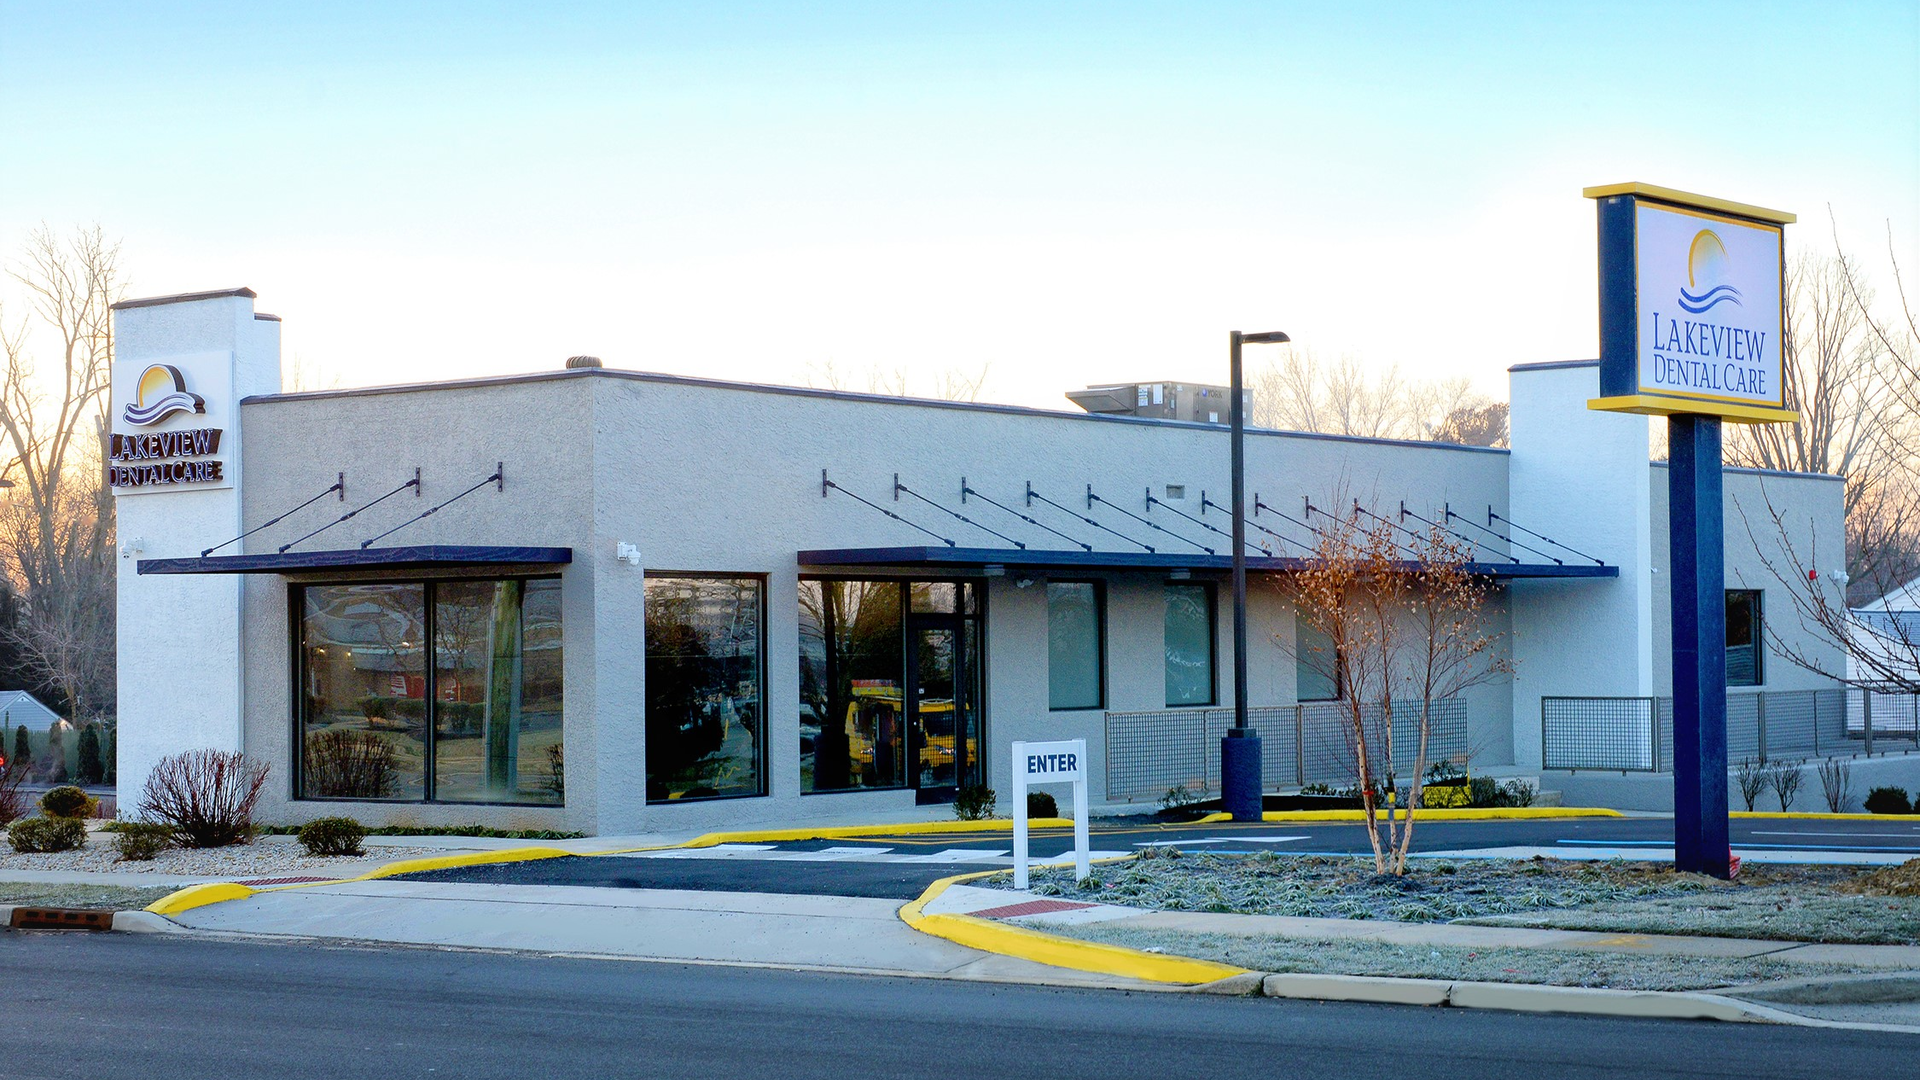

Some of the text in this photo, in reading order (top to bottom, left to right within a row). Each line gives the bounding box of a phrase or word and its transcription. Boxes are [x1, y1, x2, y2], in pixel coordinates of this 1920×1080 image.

[1653, 312, 1765, 363] LAKEVIEW
[1654, 353, 1766, 395] DENTAL CARE
[109, 429, 216, 460] LAKEVIEW
[109, 460, 216, 487] DENTAL CARE
[1027, 753, 1077, 773] ENTER
